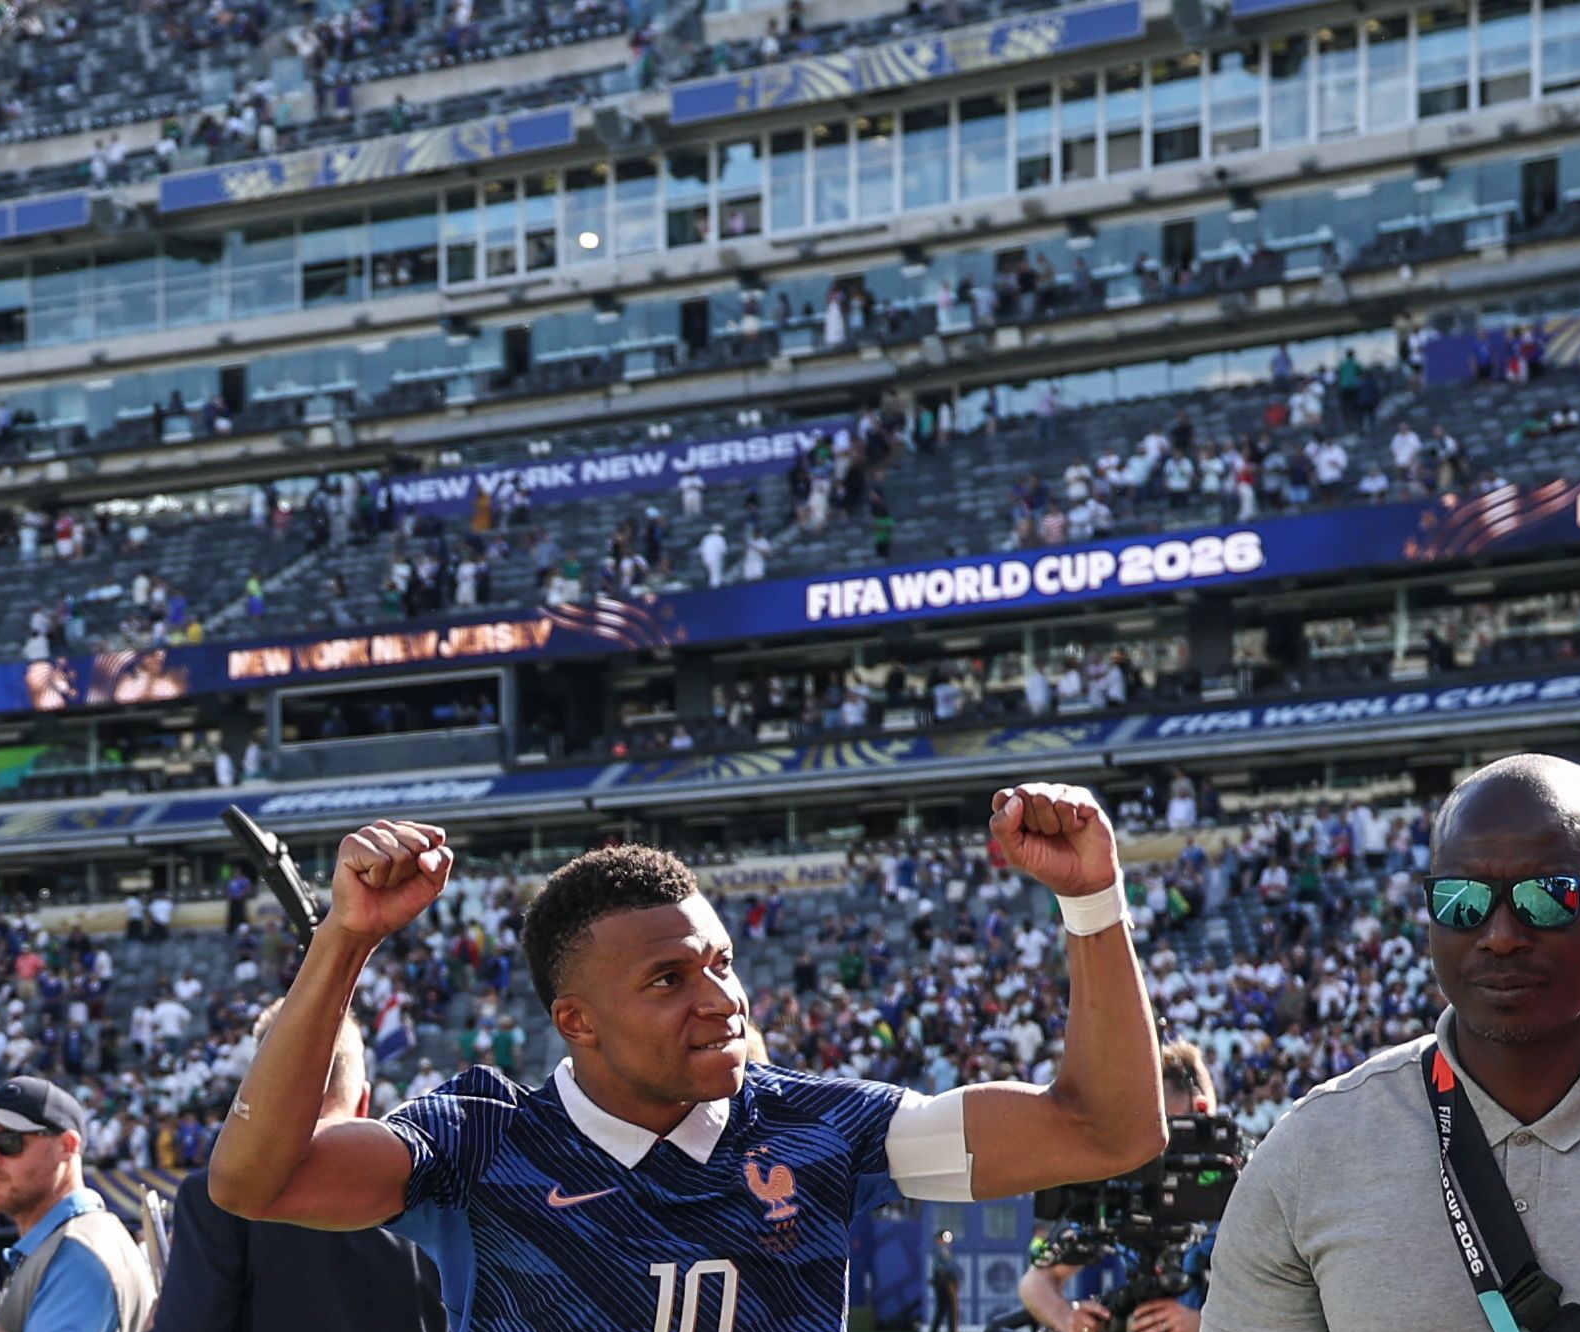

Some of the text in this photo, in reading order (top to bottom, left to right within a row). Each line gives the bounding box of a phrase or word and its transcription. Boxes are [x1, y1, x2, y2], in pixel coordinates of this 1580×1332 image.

[391, 429, 823, 504] NEW YRK NEW JERSEY
[805, 531, 1264, 621] FIFA WORLD CUP 2026
[227, 618, 554, 681] NEW YORK NEW JERSEY
[1156, 709, 1251, 738] FIFA
[1261, 692, 1432, 729] WORLD
[1433, 680, 1537, 711] CUP
[1438, 1105, 1452, 1135] FIFA
[1445, 1189, 1463, 1220] CUP
[1454, 1219, 1485, 1276] 2026
